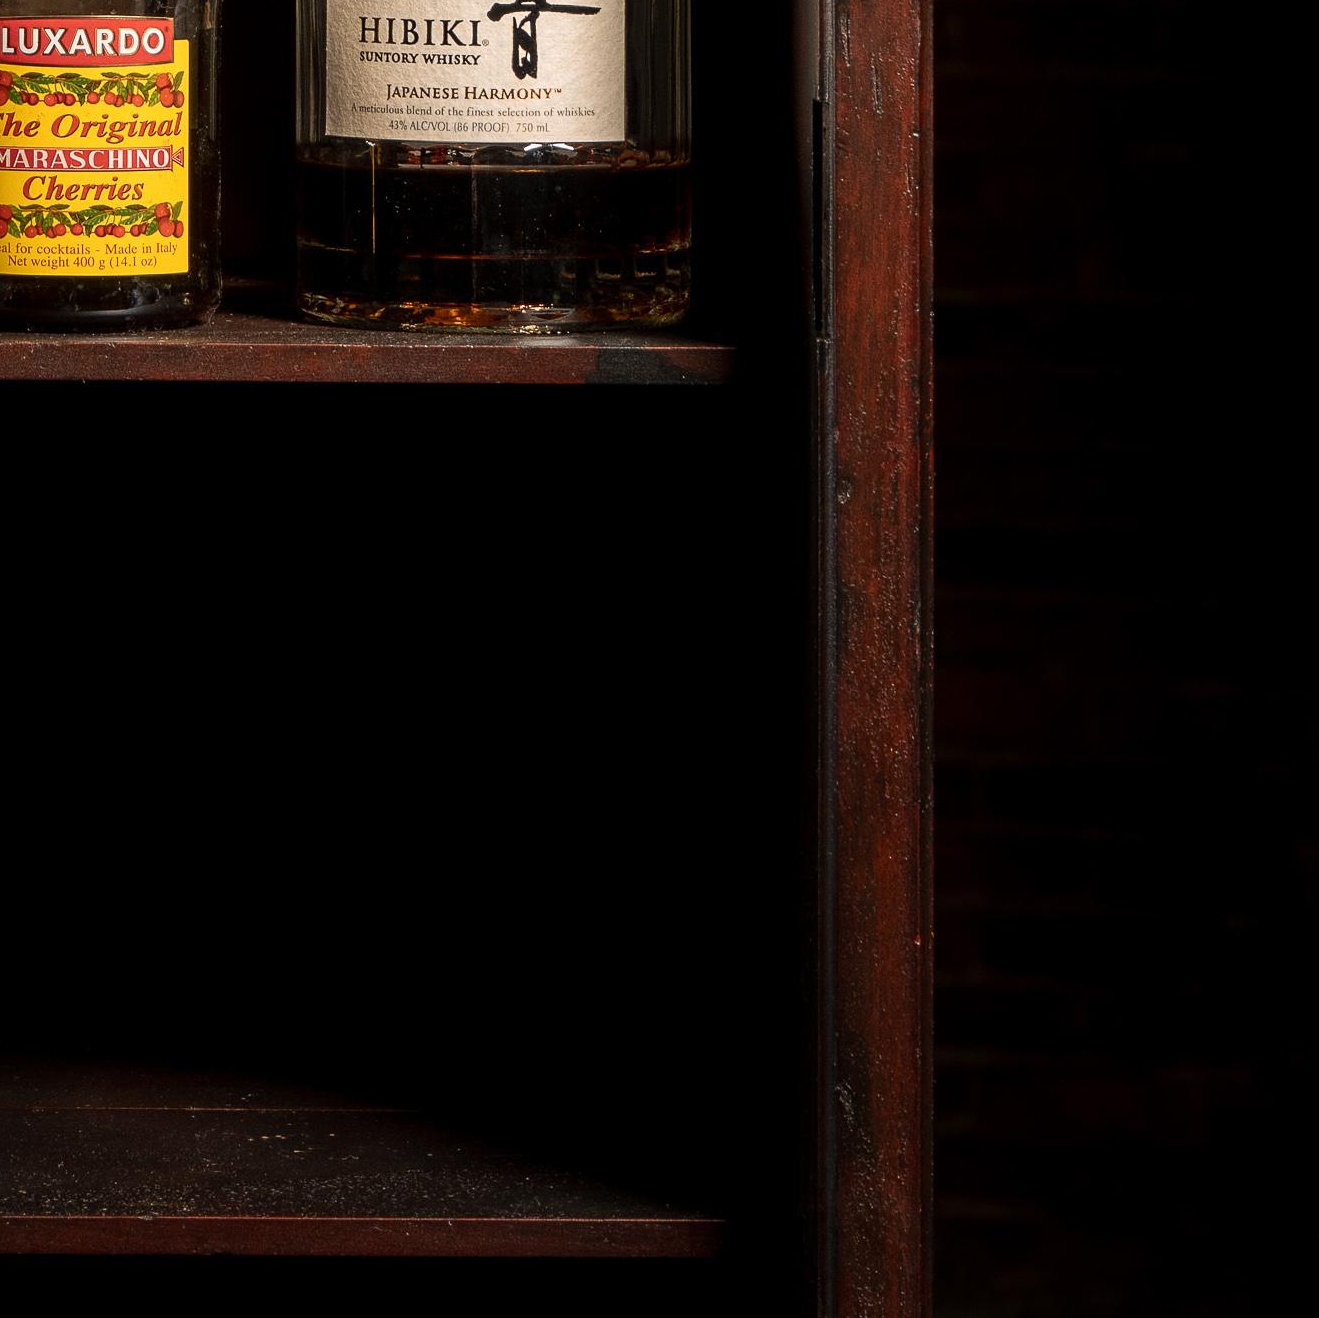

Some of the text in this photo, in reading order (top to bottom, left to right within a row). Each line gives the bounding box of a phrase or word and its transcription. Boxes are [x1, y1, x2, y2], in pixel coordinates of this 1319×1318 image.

[359, 50, 481, 66] SUNTORY WHISKY
[386, 84, 459, 101] JAPANESE
[351, 102, 596, 117] A meticulous blend of the finest selection of whiskies
[50, 111, 184, 145] Original
[388, 120, 551, 133] 43% ALC/VOL (86 PROOF) 750 mL
[22, 175, 145, 201] Cherries
[16, 242, 33, 254] for
[36, 243, 91, 255] cocktails
[105, 243, 138, 255] Made
[142, 242, 152, 254] in
[156, 242, 178, 256] Italy
[8, 254, 157, 271] Net weight 400 g (14.1 oz)
